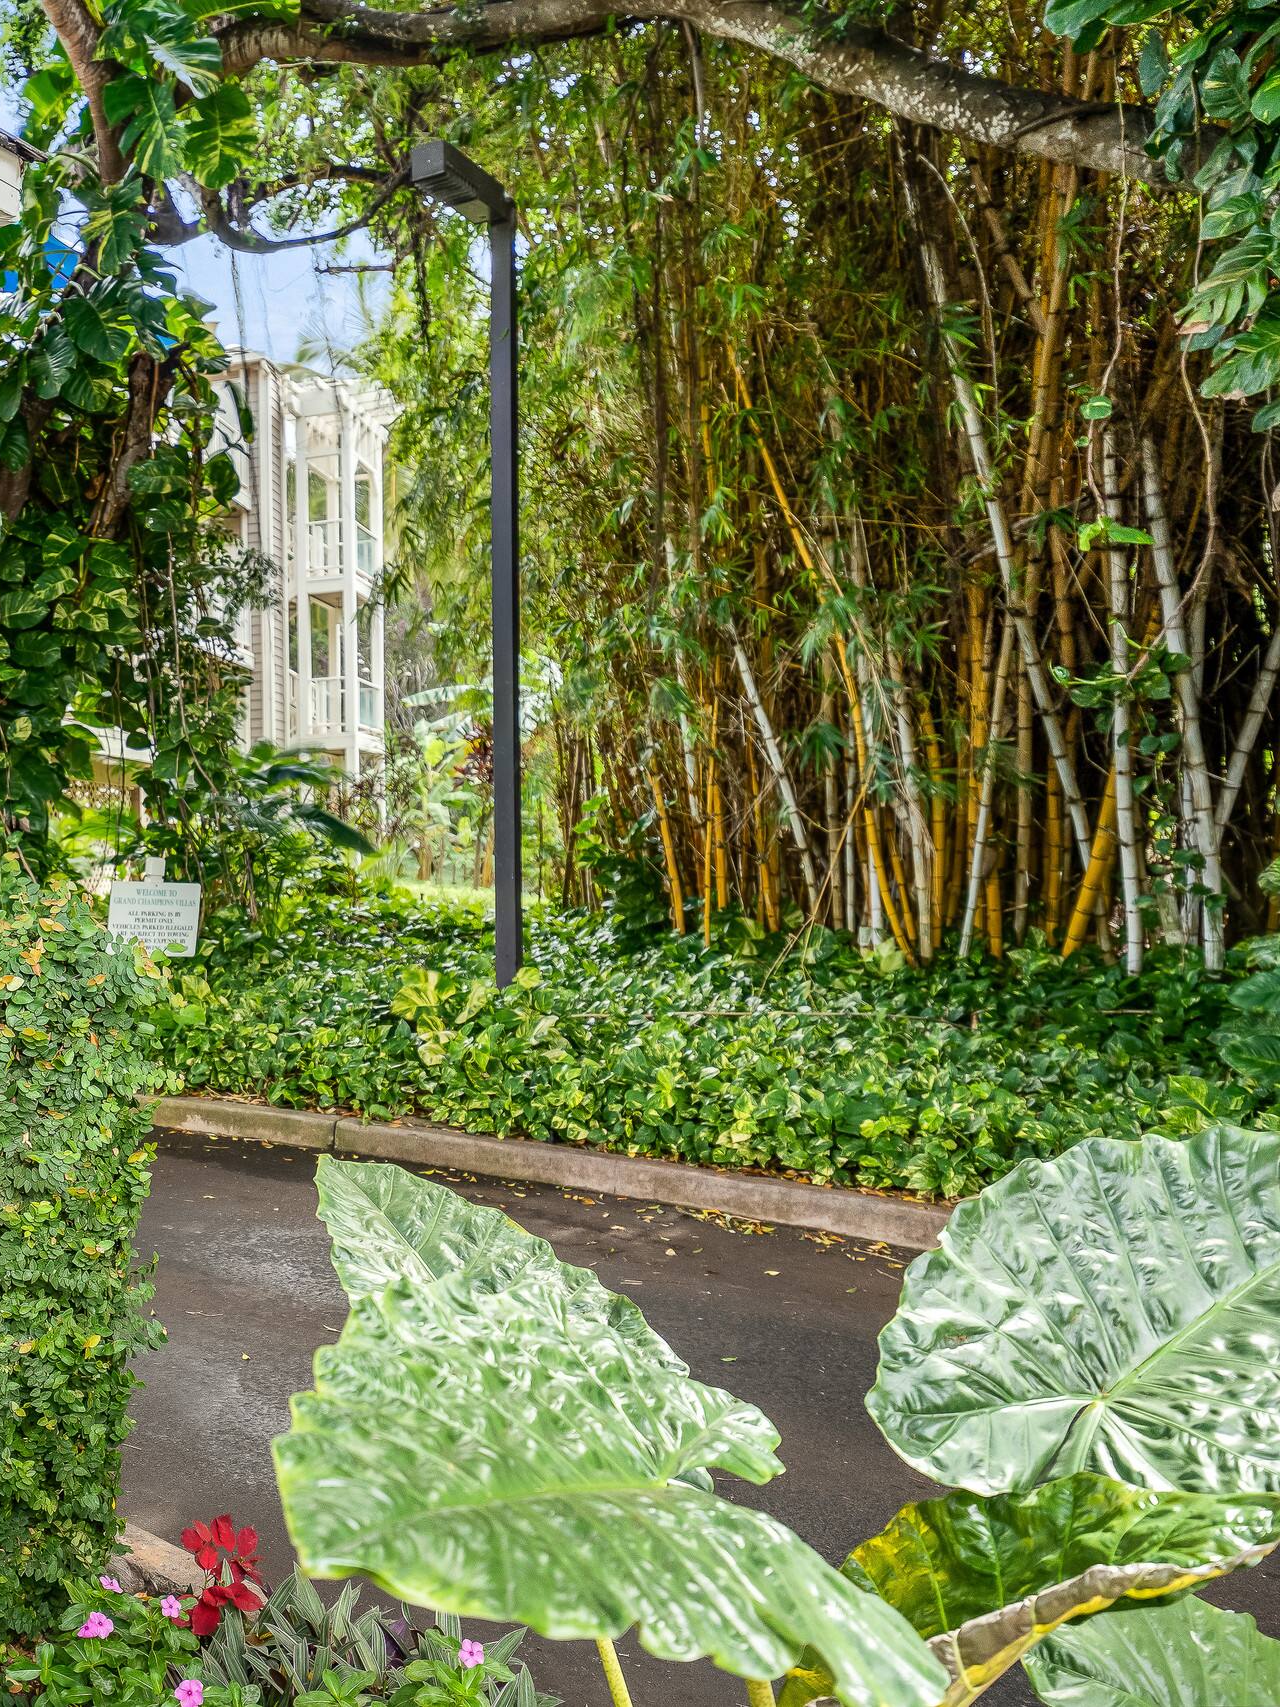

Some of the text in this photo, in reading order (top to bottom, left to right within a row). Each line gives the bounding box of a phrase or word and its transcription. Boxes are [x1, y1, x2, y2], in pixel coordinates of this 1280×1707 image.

[136, 888, 178, 897] WELCOME TO
[113, 897, 197, 907] GRAND CHAMPIONS VILLAS
